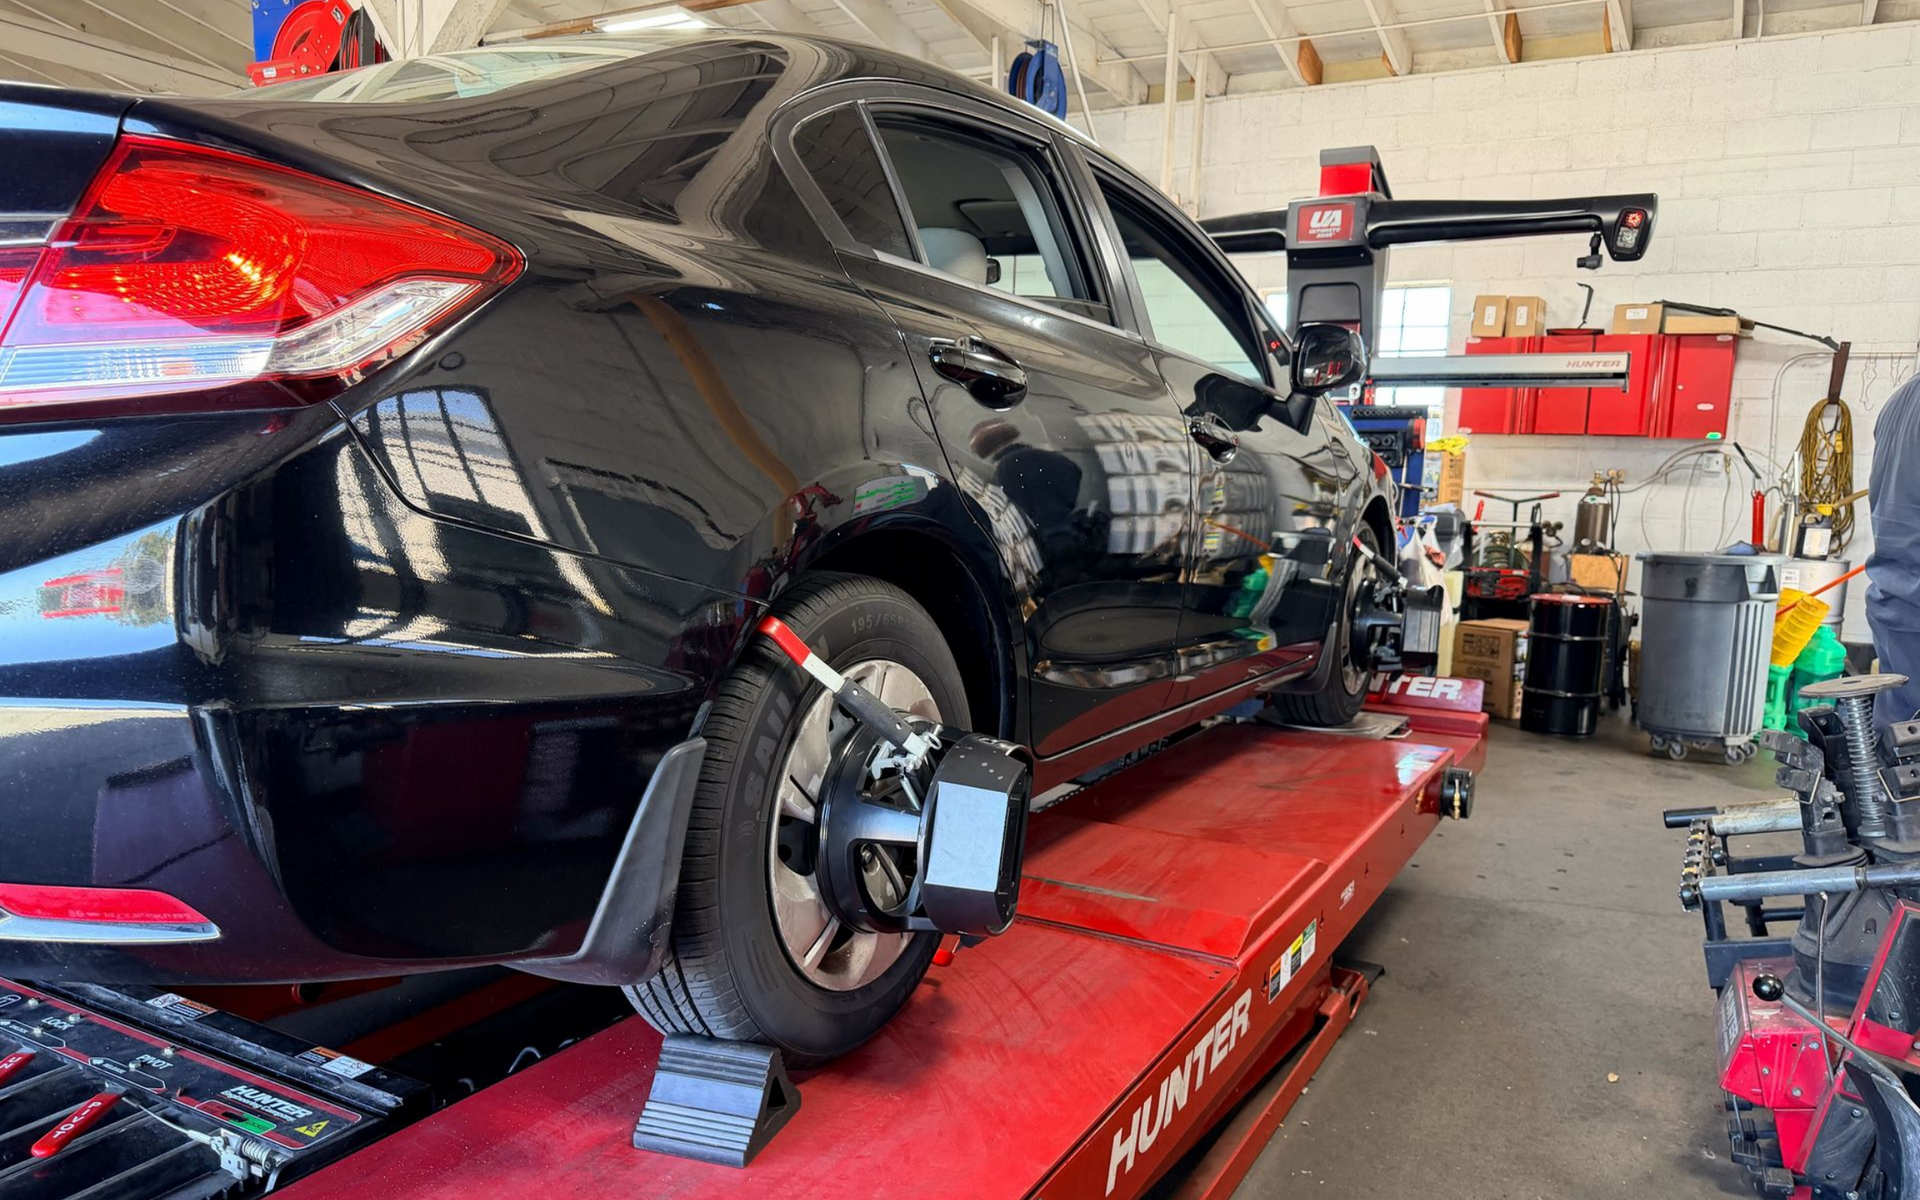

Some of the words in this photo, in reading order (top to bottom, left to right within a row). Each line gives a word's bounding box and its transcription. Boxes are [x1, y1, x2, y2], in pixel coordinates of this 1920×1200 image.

[1566, 360, 1621, 368] HUNTER
[1368, 672, 1464, 700] NTER
[135, 1053, 174, 1070] PIVOT
[220, 1090, 262, 1109] Engineering
[260, 1105, 297, 1123] Company
[228, 1085, 313, 1119] HUNTER
[1105, 988, 1252, 1198] HUNTER
[53, 1101, 102, 1139] PIVOT
